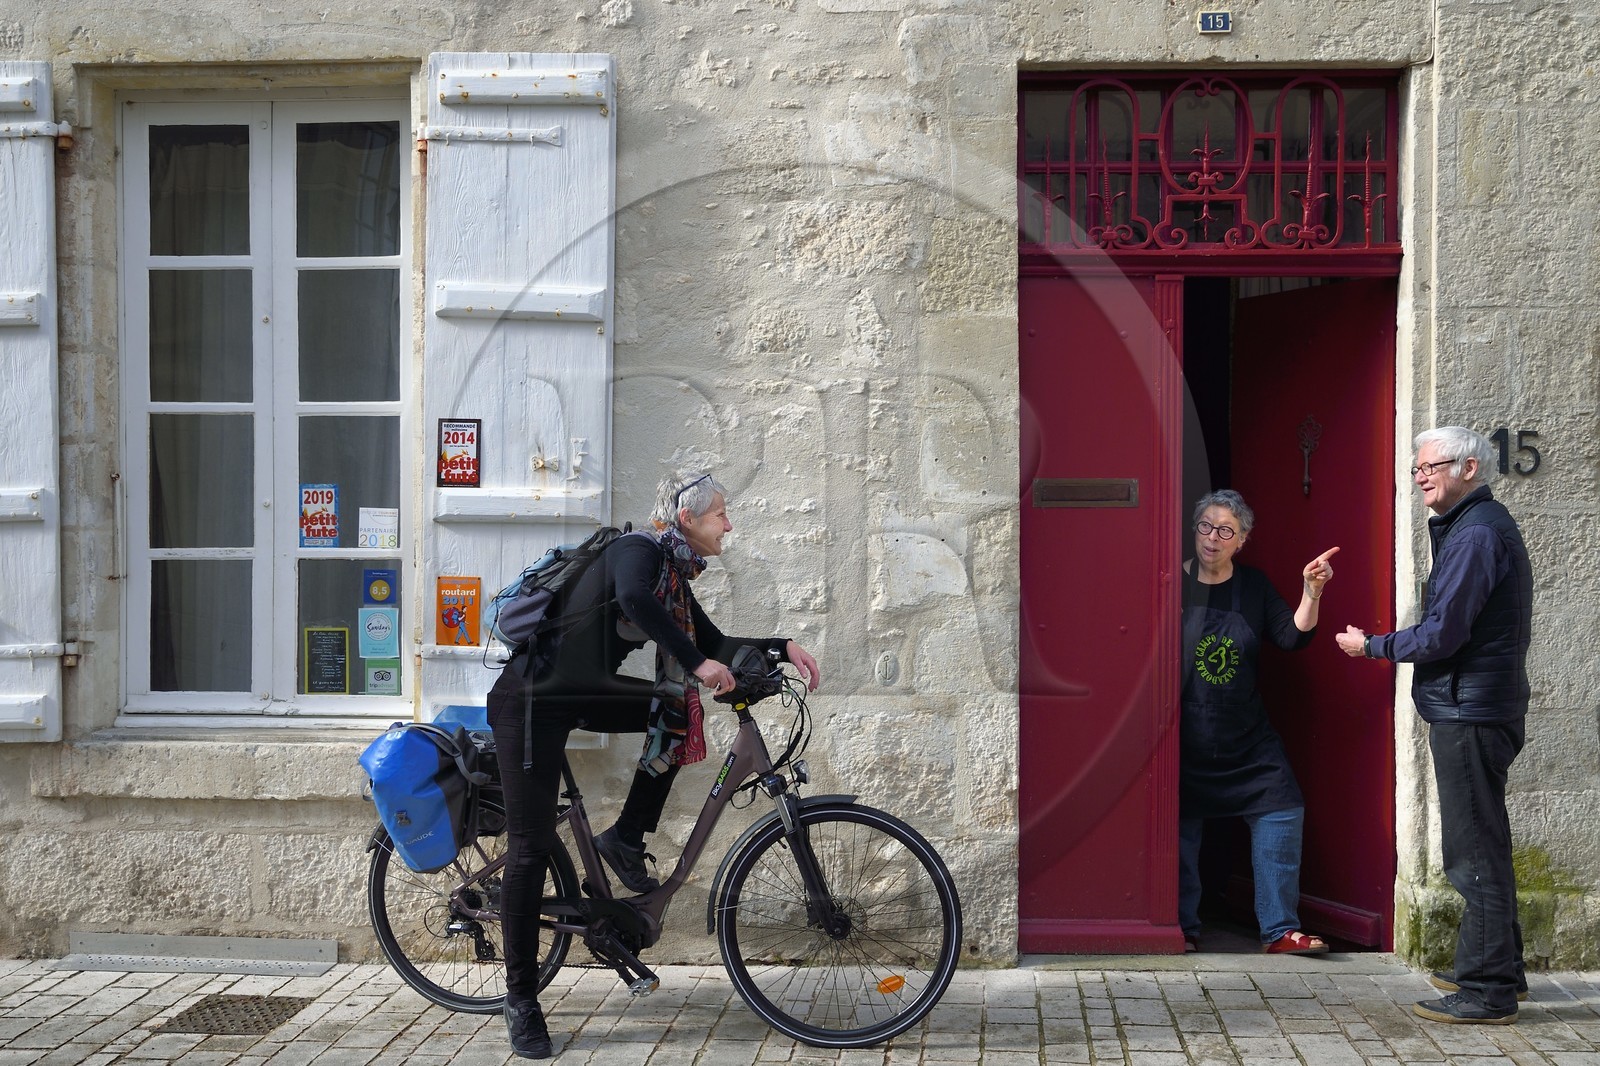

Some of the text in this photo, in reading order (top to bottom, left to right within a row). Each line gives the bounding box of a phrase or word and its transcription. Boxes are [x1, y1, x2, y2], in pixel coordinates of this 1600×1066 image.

[1207, 15, 1224, 29] 15
[443, 431, 475, 445] 2014
[1489, 428, 1540, 477] 15
[438, 456, 479, 473] petit
[303, 490, 334, 504] 2019
[299, 512, 338, 528] petit
[359, 534, 397, 547] 2018
[372, 586, 387, 596] 8,5
[441, 588, 476, 596] routard
[442, 596, 475, 605] 2011
[1195, 634, 1240, 685] CAMPO DE LAS CAZADORAS
